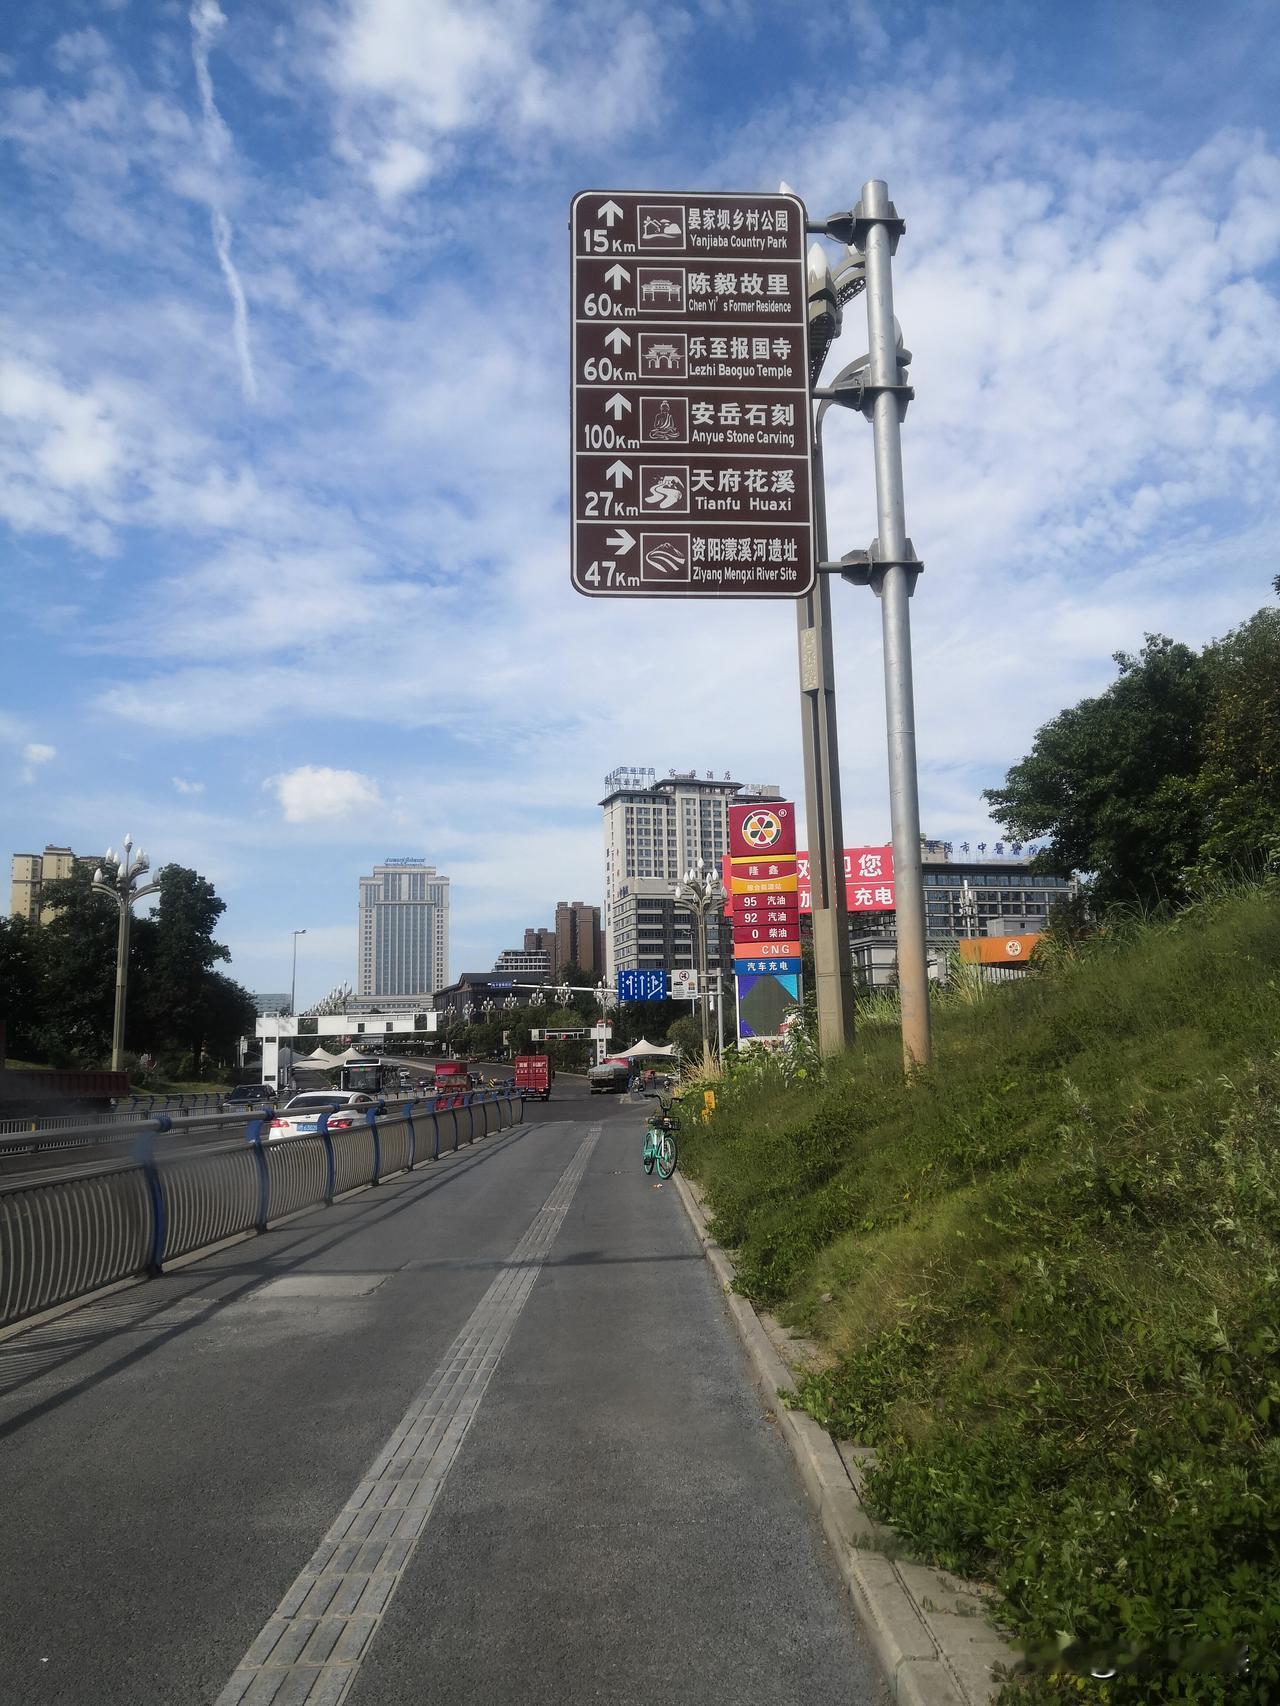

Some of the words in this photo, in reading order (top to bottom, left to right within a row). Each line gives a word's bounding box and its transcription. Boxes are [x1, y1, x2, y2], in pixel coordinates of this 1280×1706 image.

[687, 207, 789, 232] 晏家坝乡村公园
[690, 234, 729, 250] Yanjiaba
[730, 235, 766, 250] Country
[767, 236, 788, 249] Park
[687, 272, 790, 295] 陈毅故里
[688, 298, 707, 312] Chen
[728, 299, 755, 313] Former
[755, 300, 792, 313] Residence
[688, 336, 792, 360] 乐至报国寺
[689, 362, 716, 377] Lezhi
[718, 363, 755, 380] Baoguo
[756, 364, 793, 379] Temple
[690, 401, 795, 426] 安岳石刻
[691, 431, 724, 446] Anyue
[726, 431, 755, 444] Stone
[756, 431, 795, 448] Carving
[690, 468, 796, 493] 天府花溪
[695, 496, 741, 511] Tianfu
[749, 497, 793, 511] Huaxi
[691, 536, 799, 562] 资阳濛溪河遗址
[692, 566, 723, 584] Ziyang
[724, 566, 755, 584] Mengxi
[756, 567, 779, 581] River
[780, 567, 798, 581] Site
[743, 896, 758, 907] 95
[767, 895, 786, 906] 汽油
[744, 912, 758, 923] 92
[767, 911, 787, 922] 汽油
[751, 929, 759, 939] 0
[768, 927, 788, 938] 柴油
[761, 944, 790, 955] CNG
[747, 960, 789, 972] 汽车充电
